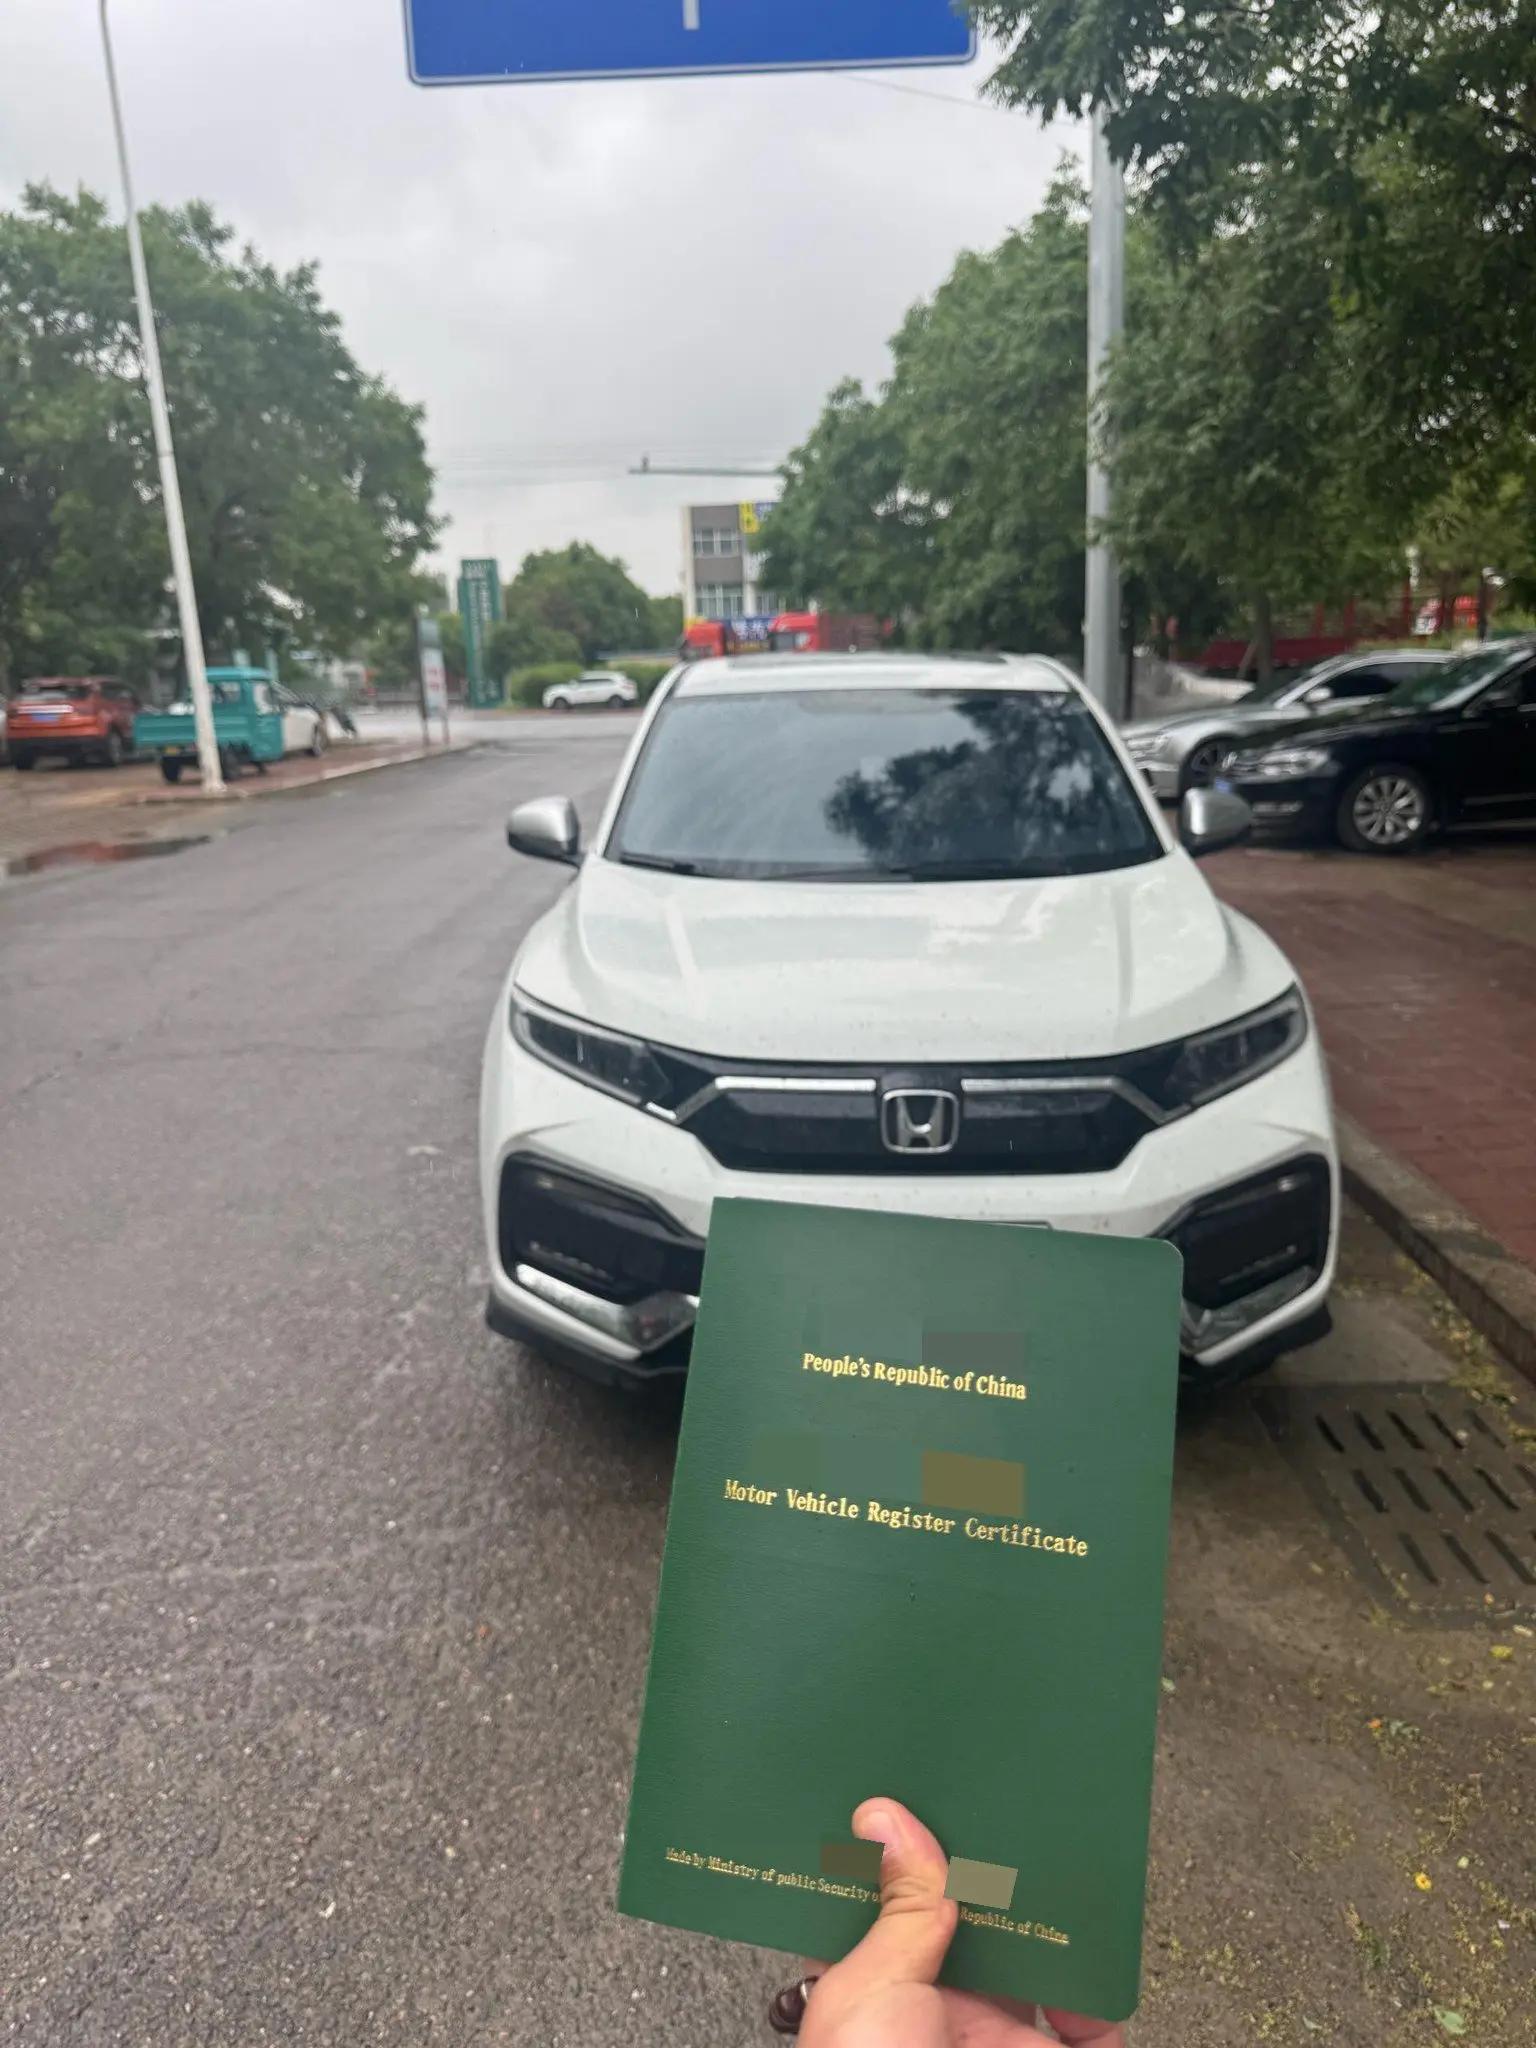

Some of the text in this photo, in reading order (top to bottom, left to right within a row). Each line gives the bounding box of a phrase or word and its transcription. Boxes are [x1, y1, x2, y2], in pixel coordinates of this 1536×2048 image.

[803, 1353, 1026, 1400] People's Republic of China
[724, 1479, 1089, 1557] Motor Vehicle Register Certificate
[666, 1847, 691, 1865] Made
[692, 1853, 706, 1868] by
[707, 1856, 759, 1880] Ministry
[761, 1868, 776, 1882] of
[777, 1873, 817, 1891] public
[817, 1877, 870, 1903] Security
[960, 1906, 1014, 1931] Republic
[1017, 1920, 1031, 1935] of
[1035, 1922, 1070, 1944] China
